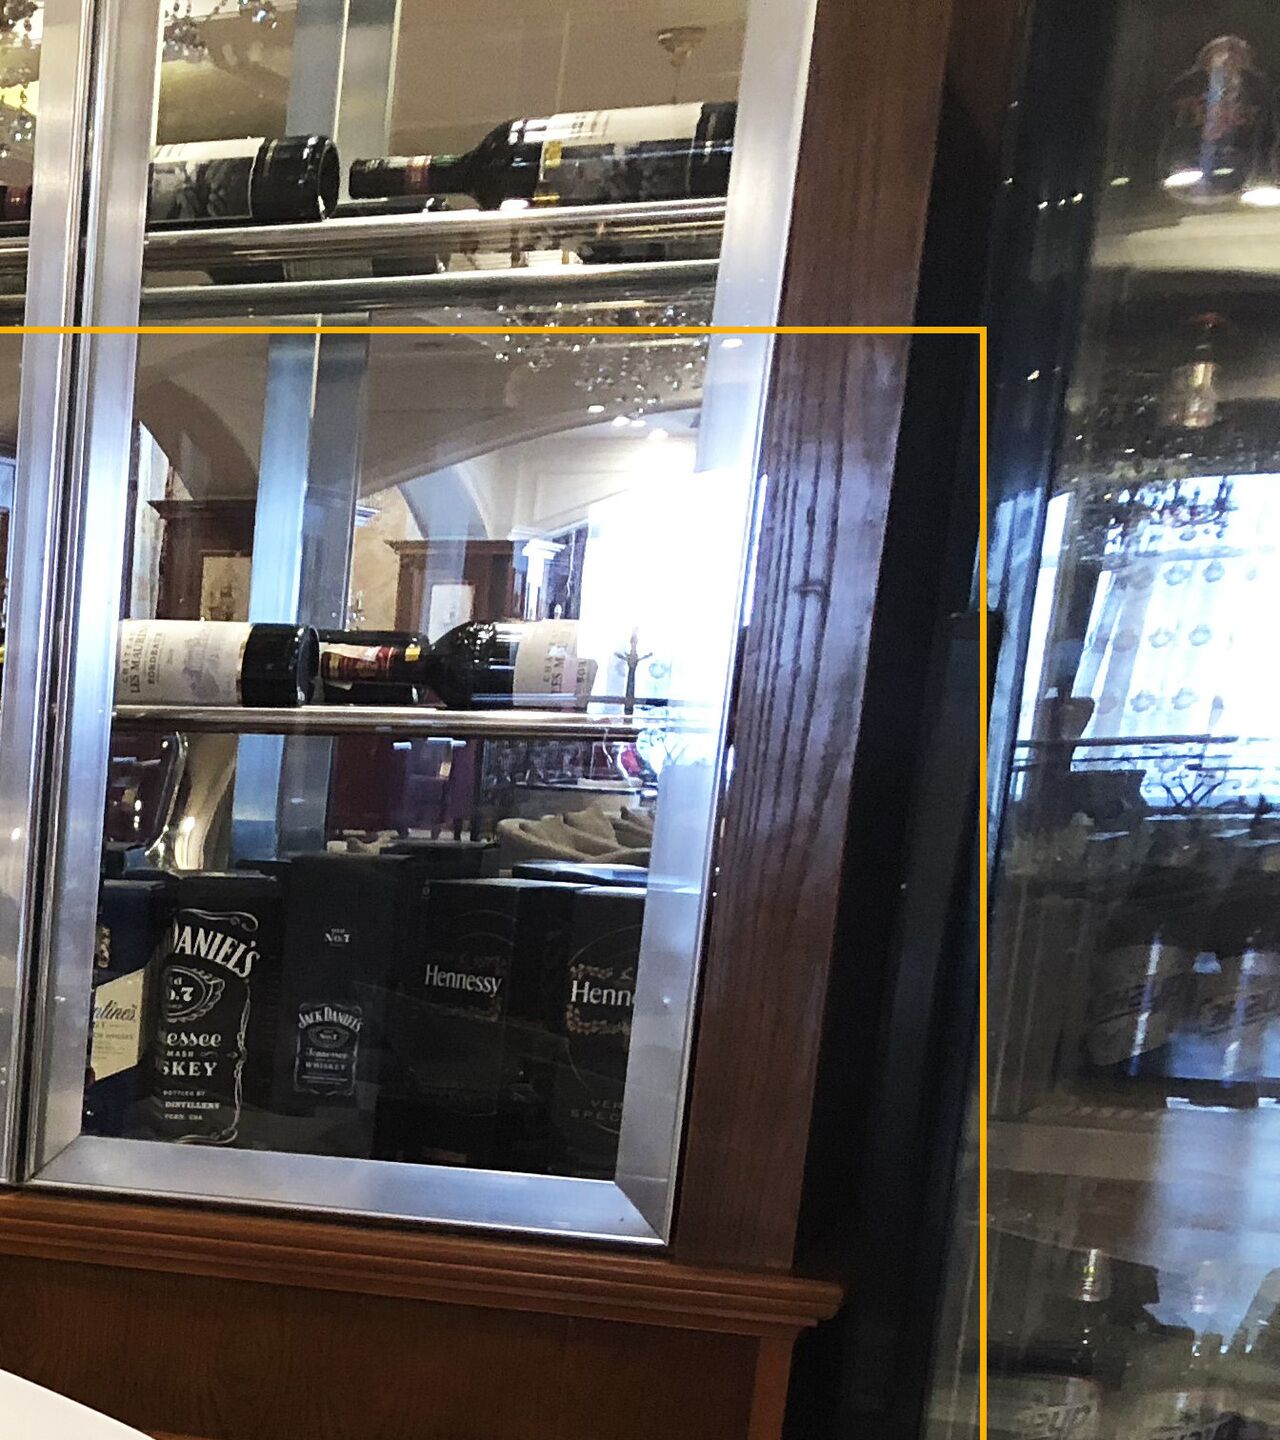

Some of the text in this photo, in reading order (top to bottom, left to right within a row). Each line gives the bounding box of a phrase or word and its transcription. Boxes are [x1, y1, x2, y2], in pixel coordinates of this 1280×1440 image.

[424, 963, 503, 998] Hennessy
[570, 980, 636, 1008] Henn
[297, 1006, 364, 1033] JACK DANIEL'S
[165, 1031, 222, 1048] essee
[162, 1061, 218, 1077] SKEY
